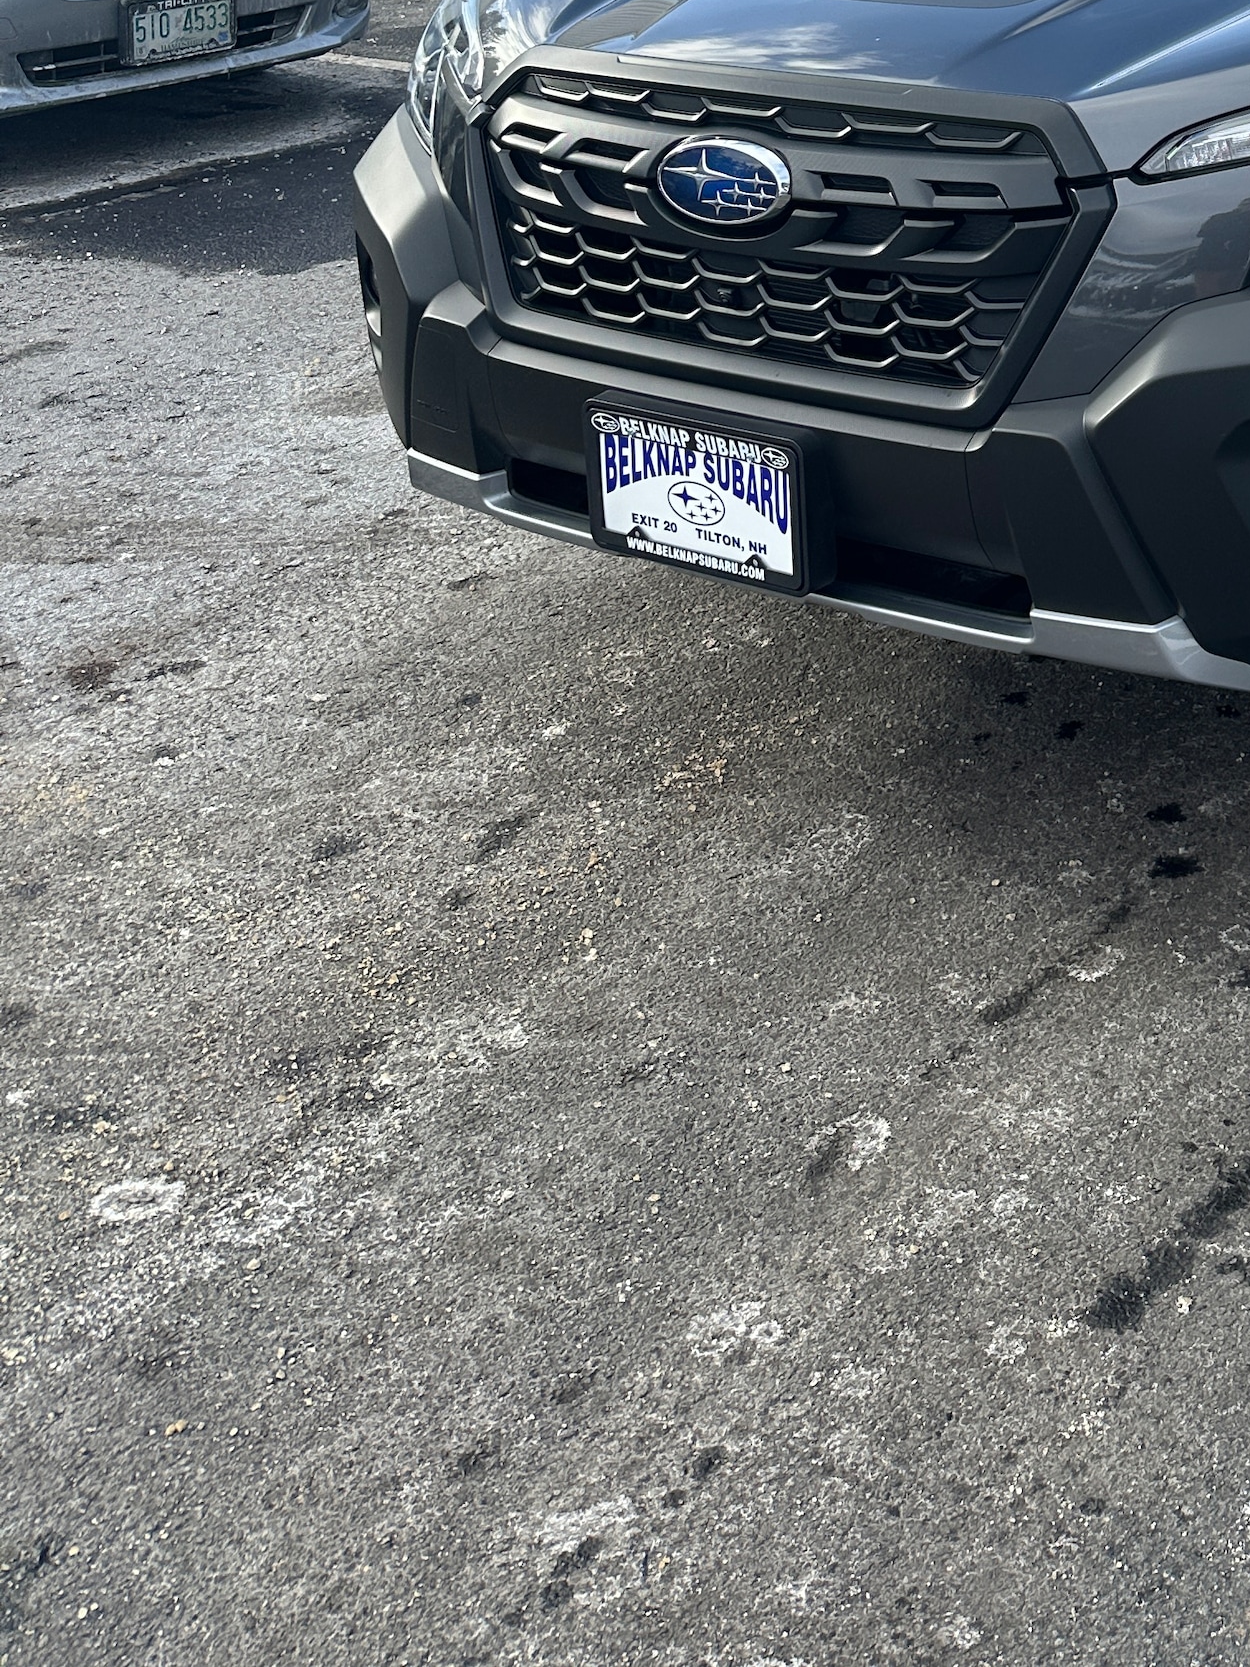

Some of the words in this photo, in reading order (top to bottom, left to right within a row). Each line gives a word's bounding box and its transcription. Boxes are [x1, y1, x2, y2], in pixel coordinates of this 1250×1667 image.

[135, 12, 170, 43] 510
[182, 2, 229, 34] 4533
[618, 416, 691, 449] BELKNAP
[694, 431, 762, 465] SUBARU
[604, 433, 697, 494] BELKNAP
[702, 452, 790, 535] SUBARU
[631, 512, 660, 529] EXIT
[663, 520, 678, 533] 20
[695, 527, 745, 552] TILTON,
[748, 539, 768, 555] NH
[626, 535, 765, 581] WWW.BELKNAPSUBARU.COM
